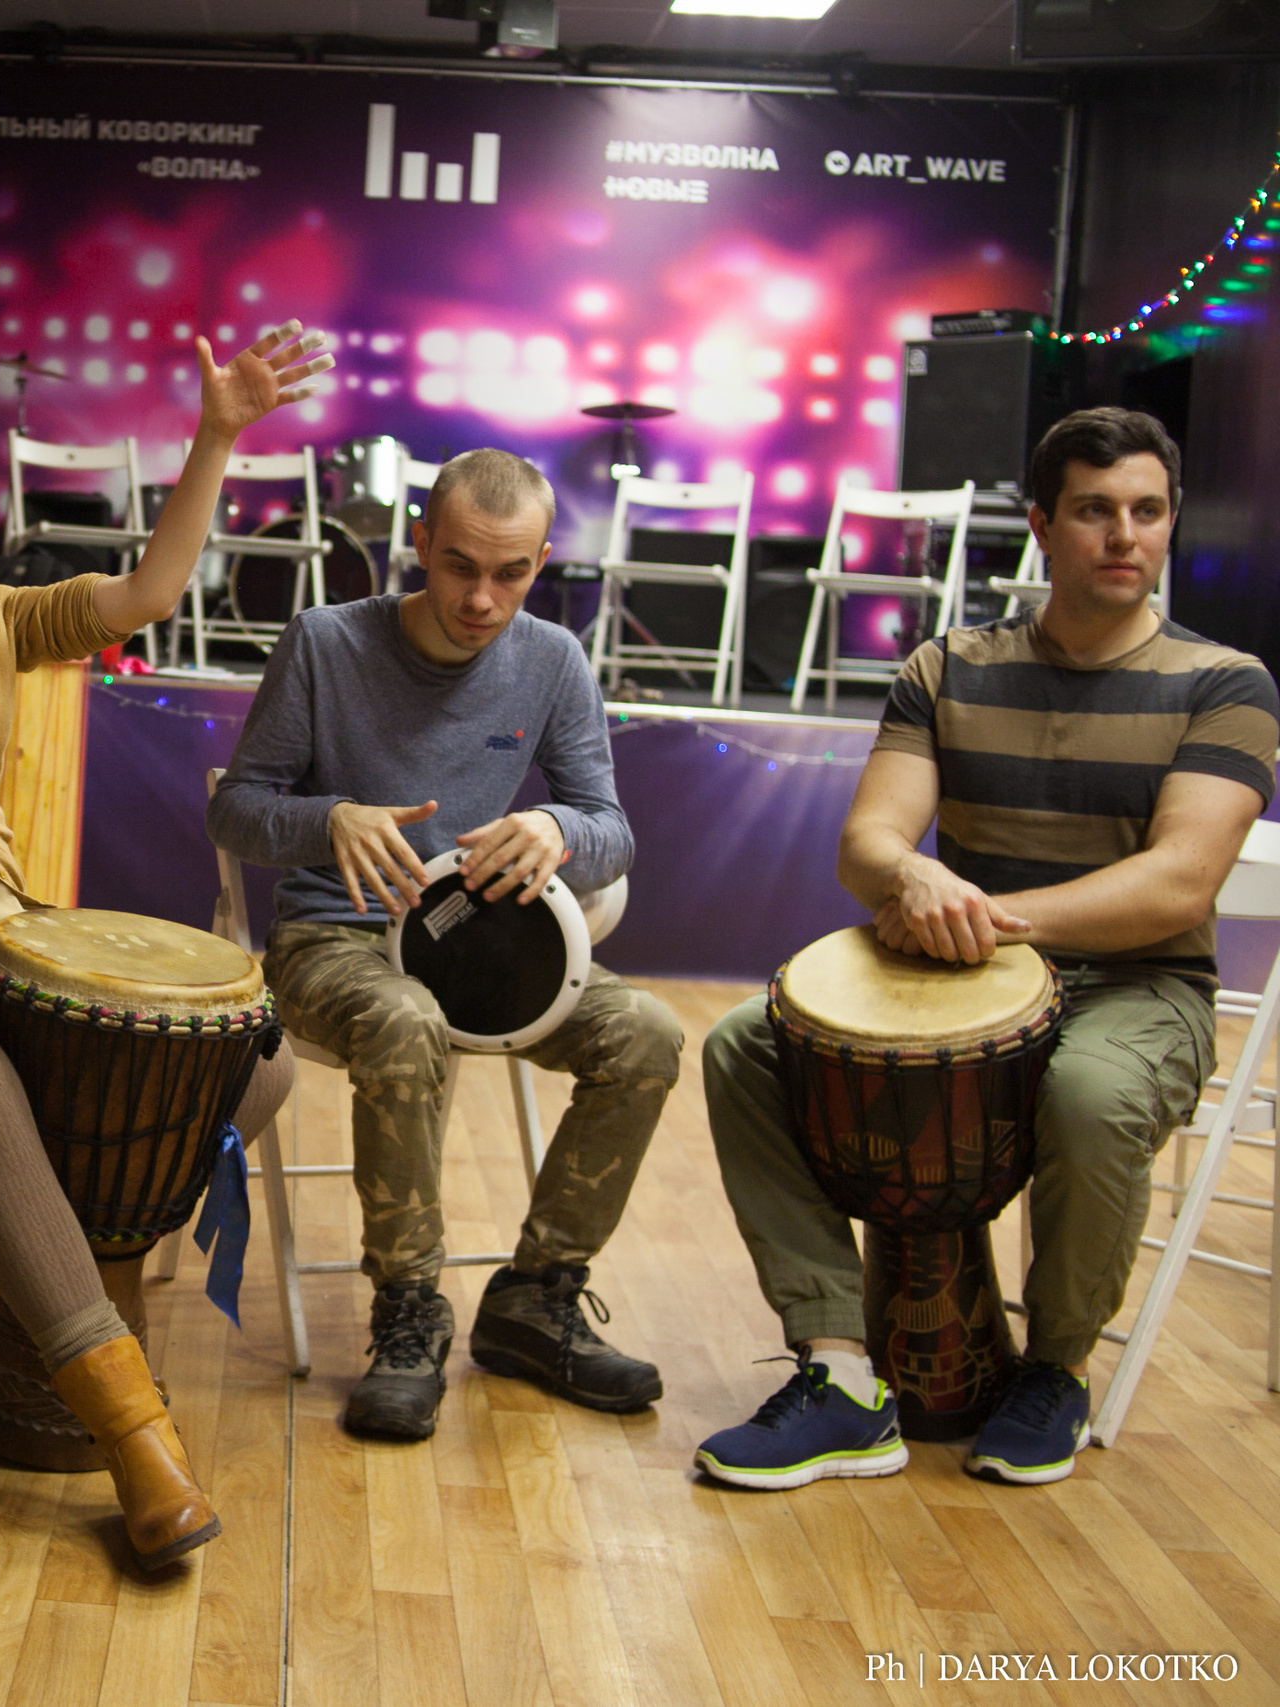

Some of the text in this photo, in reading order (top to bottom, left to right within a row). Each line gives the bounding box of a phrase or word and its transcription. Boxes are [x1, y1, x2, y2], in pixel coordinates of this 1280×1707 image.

[97, 119, 263, 145] КОВОРКИНГ
[136, 156, 262, 181] «ВОЛНА»
[605, 139, 780, 172] #МУЗВОЛНА
[852, 153, 1007, 184] ART_WAVE
